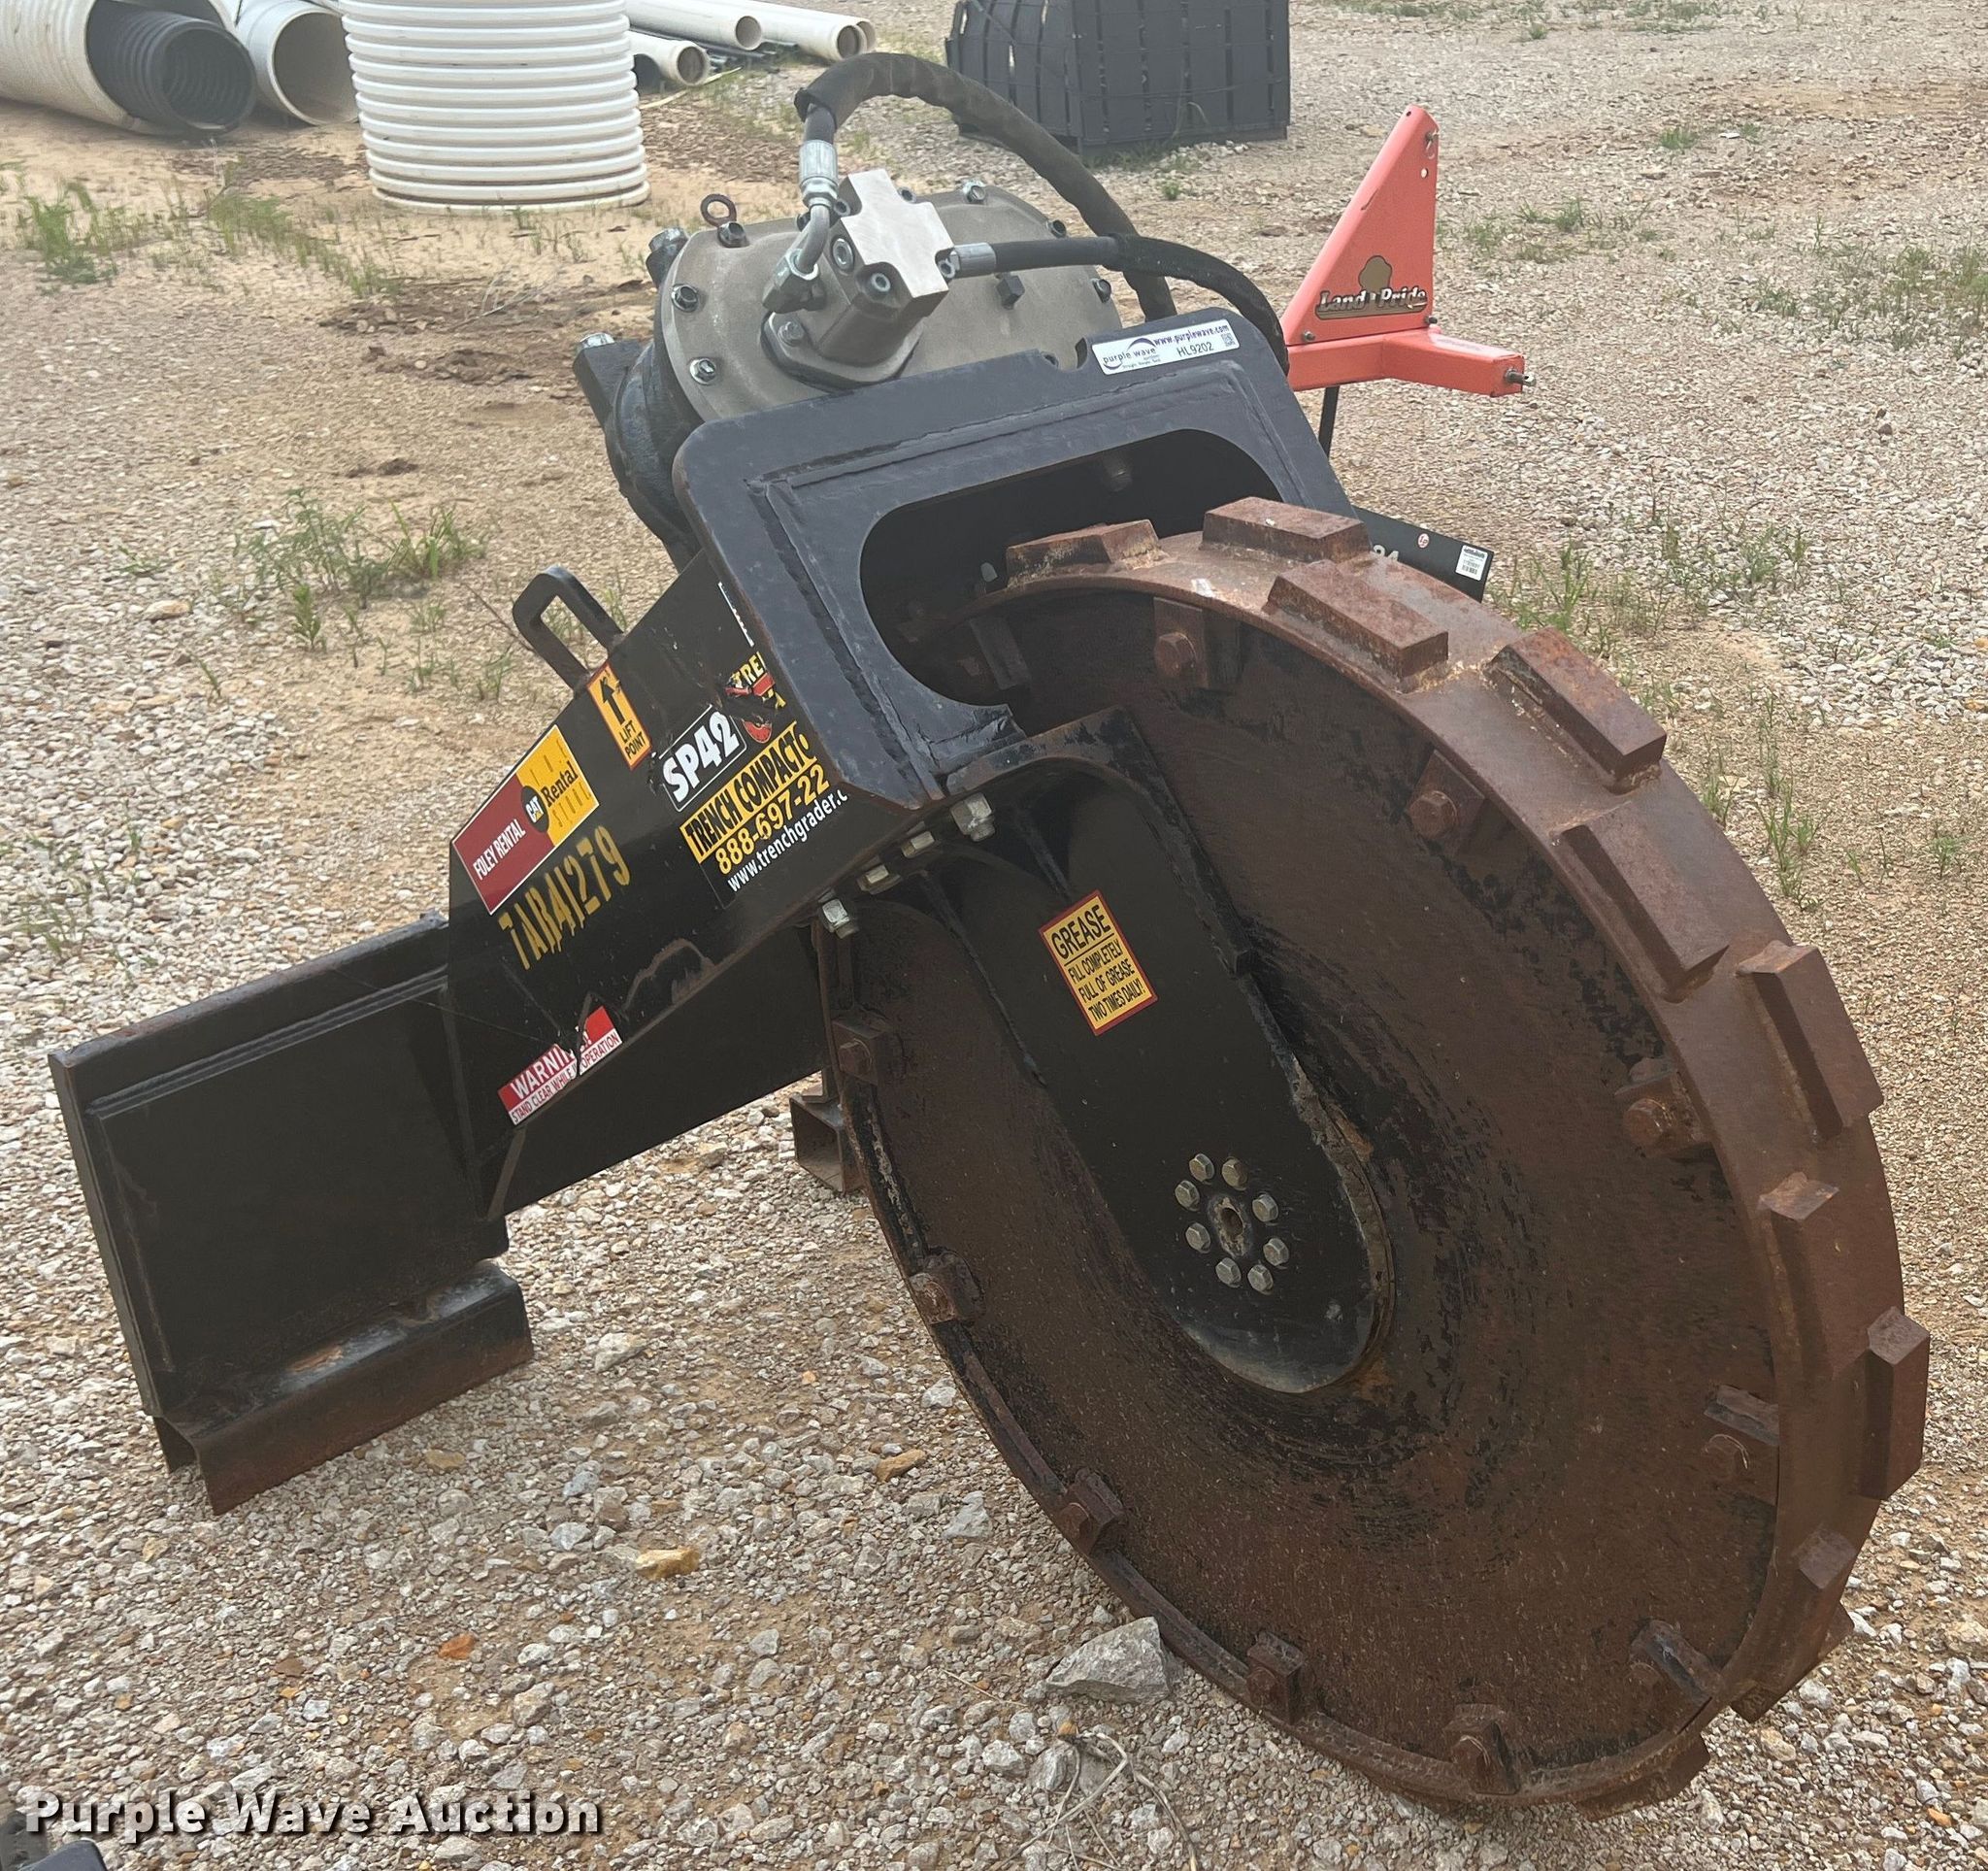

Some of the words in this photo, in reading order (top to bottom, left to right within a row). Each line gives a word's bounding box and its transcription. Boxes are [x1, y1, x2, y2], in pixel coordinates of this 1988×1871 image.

[1318, 289, 1367, 311] Land
[1378, 285, 1427, 309] Pride
[1103, 351, 1131, 365] purple
[1133, 348, 1156, 357] wave
[1153, 324, 1230, 347] www.purplewave.com
[1176, 341, 1214, 357] HL9202
[619, 719, 637, 744] LIFT
[624, 730, 646, 759] POINT
[663, 711, 740, 803] SP42
[525, 794, 544, 823] CAT
[540, 760, 580, 808] Rental
[684, 788, 744, 856] TRENCH
[472, 846, 500, 881] FOLEY
[493, 819, 526, 859] RENTAL
[1051, 904, 1111, 959] GREASE
[1068, 963, 1086, 985] FILL
[1083, 939, 1124, 976] COMPLETELY
[1078, 981, 1100, 1003] FULL
[1095, 974, 1109, 992] OF
[1106, 958, 1136, 986] GREASE
[1088, 998, 1109, 1021] TWO
[1103, 989, 1127, 1016] TIMES
[1122, 977, 1146, 1002] DAILY!
[512, 1100, 533, 1123] STAND
[532, 1085, 553, 1107] CLEAR
[551, 1068, 574, 1092] WHILE
[581, 1032, 620, 1069] OPERATION
